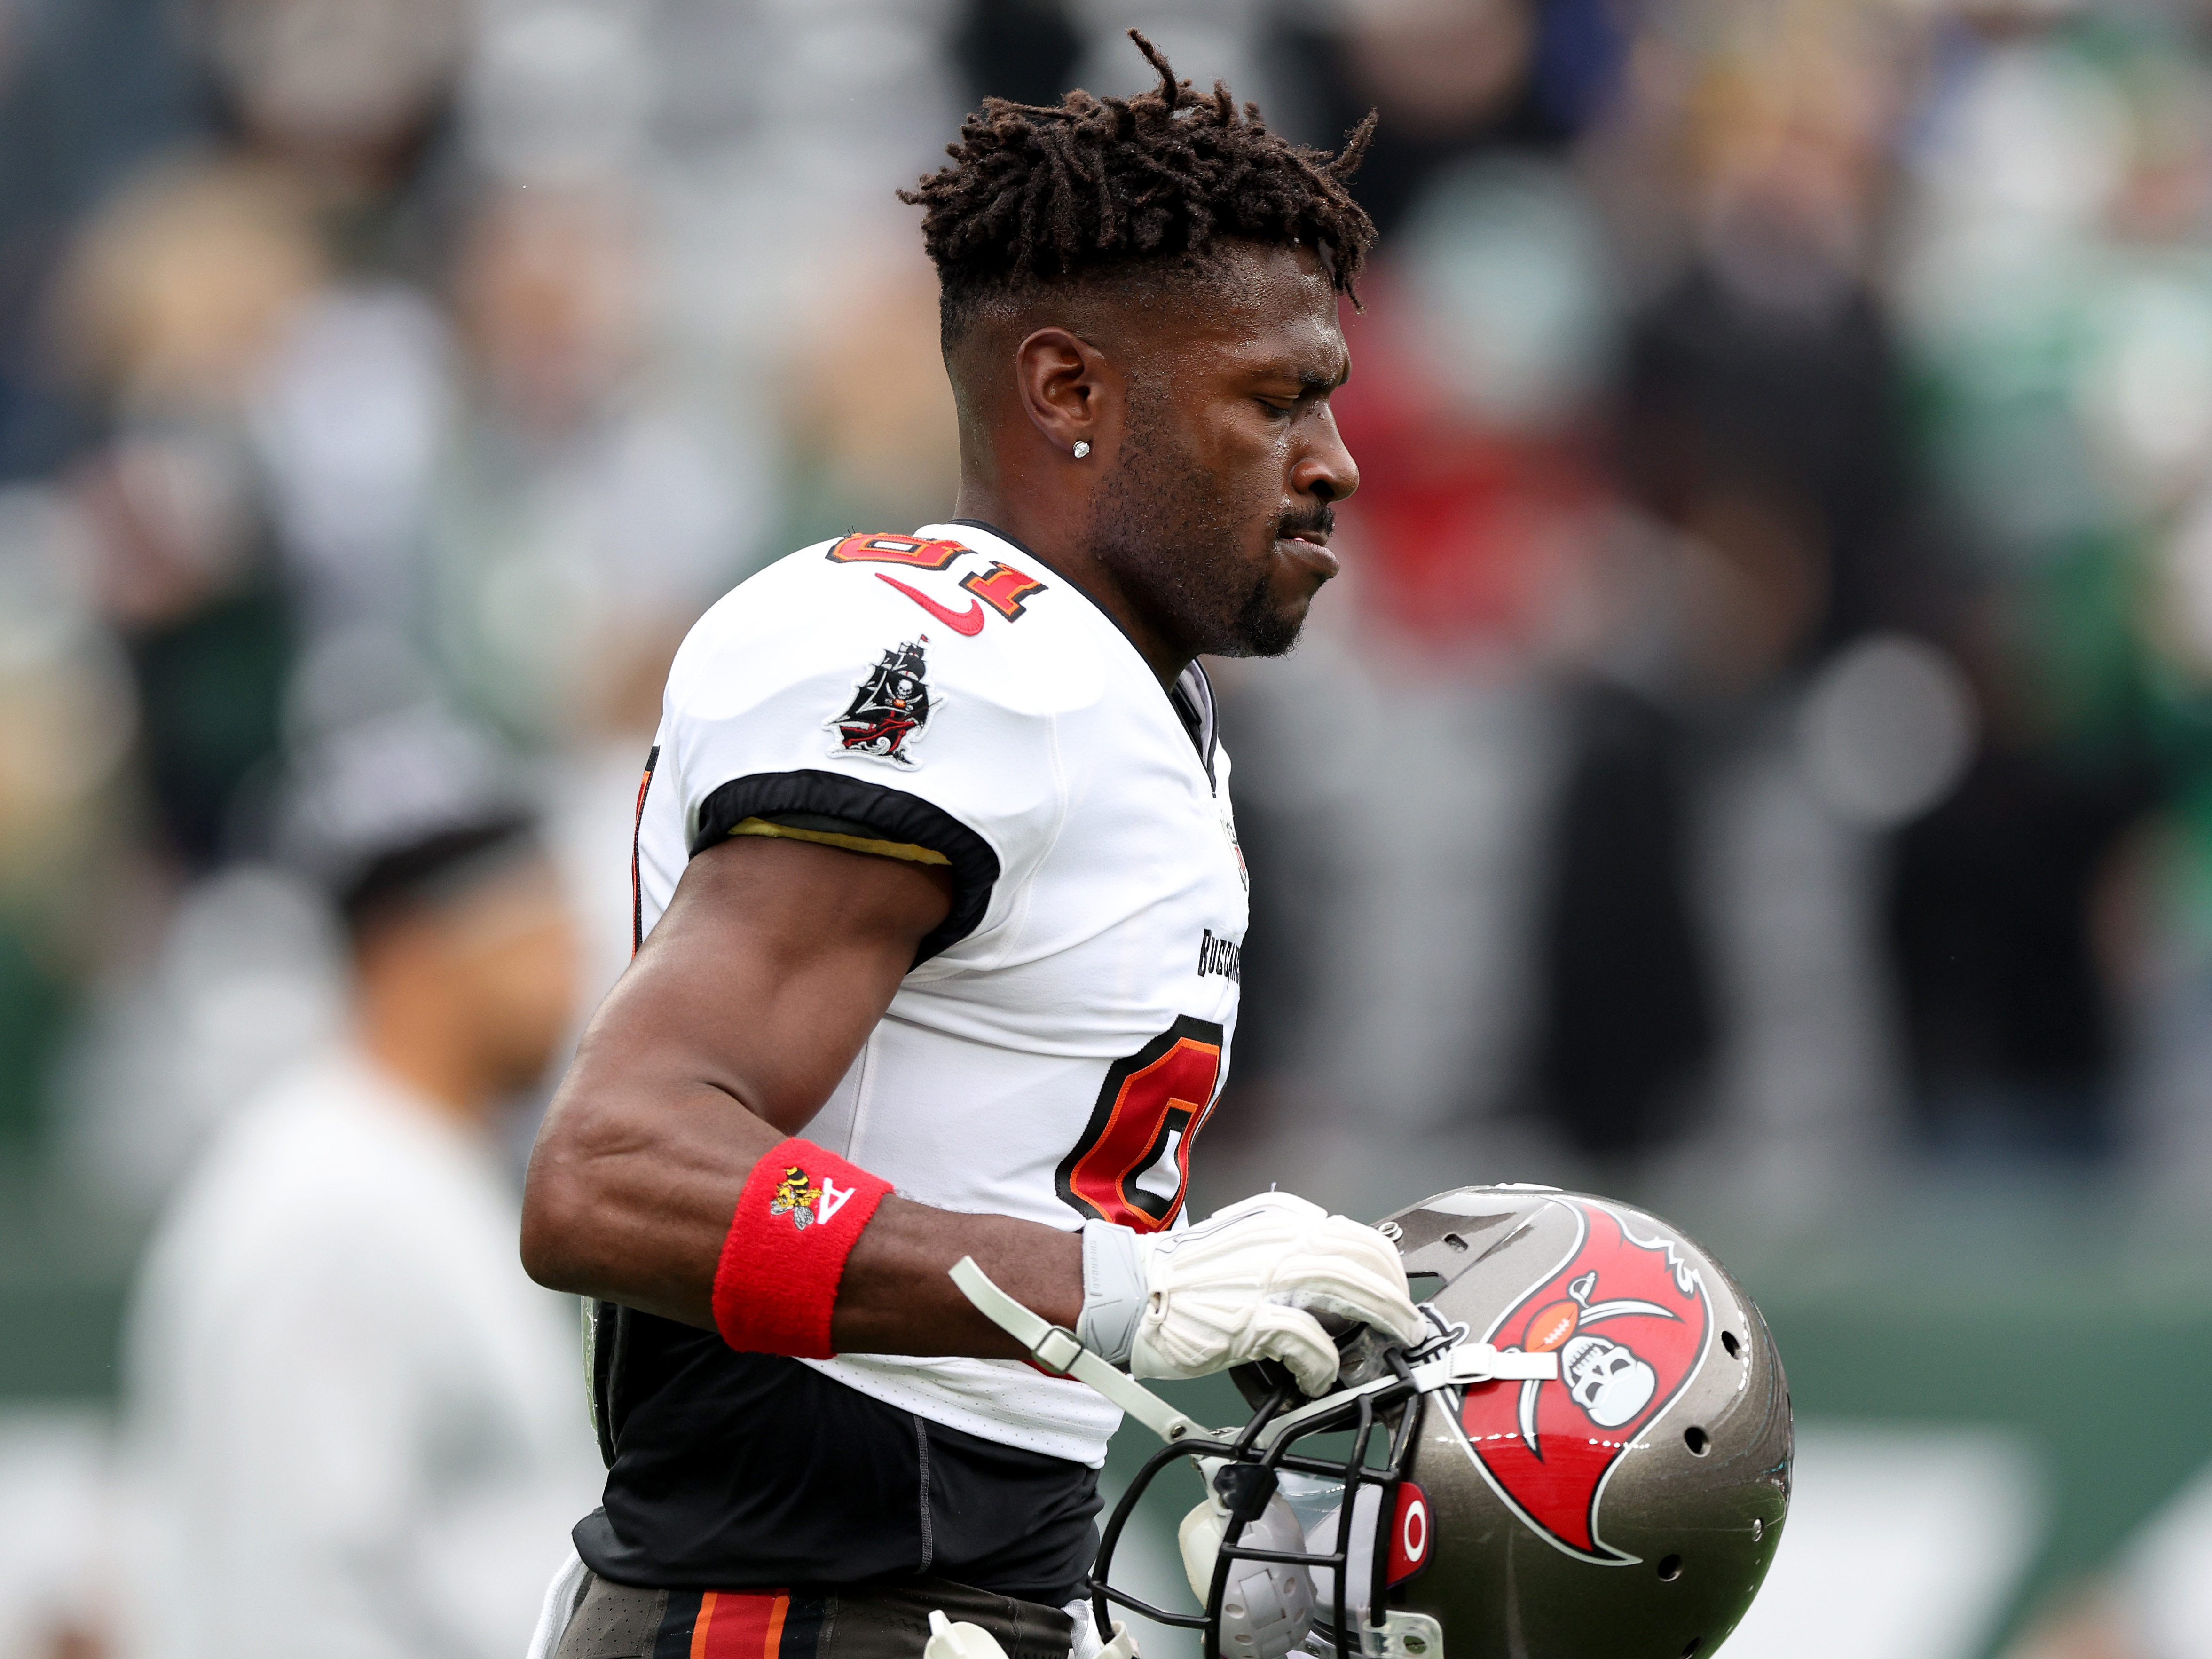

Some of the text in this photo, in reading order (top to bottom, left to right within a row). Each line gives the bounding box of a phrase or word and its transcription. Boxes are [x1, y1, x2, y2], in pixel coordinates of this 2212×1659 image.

[1054, 1013, 1224, 1235] 8
[817, 1177, 857, 1225] A
[1089, 1240, 1101, 1290] SUPERBAD
